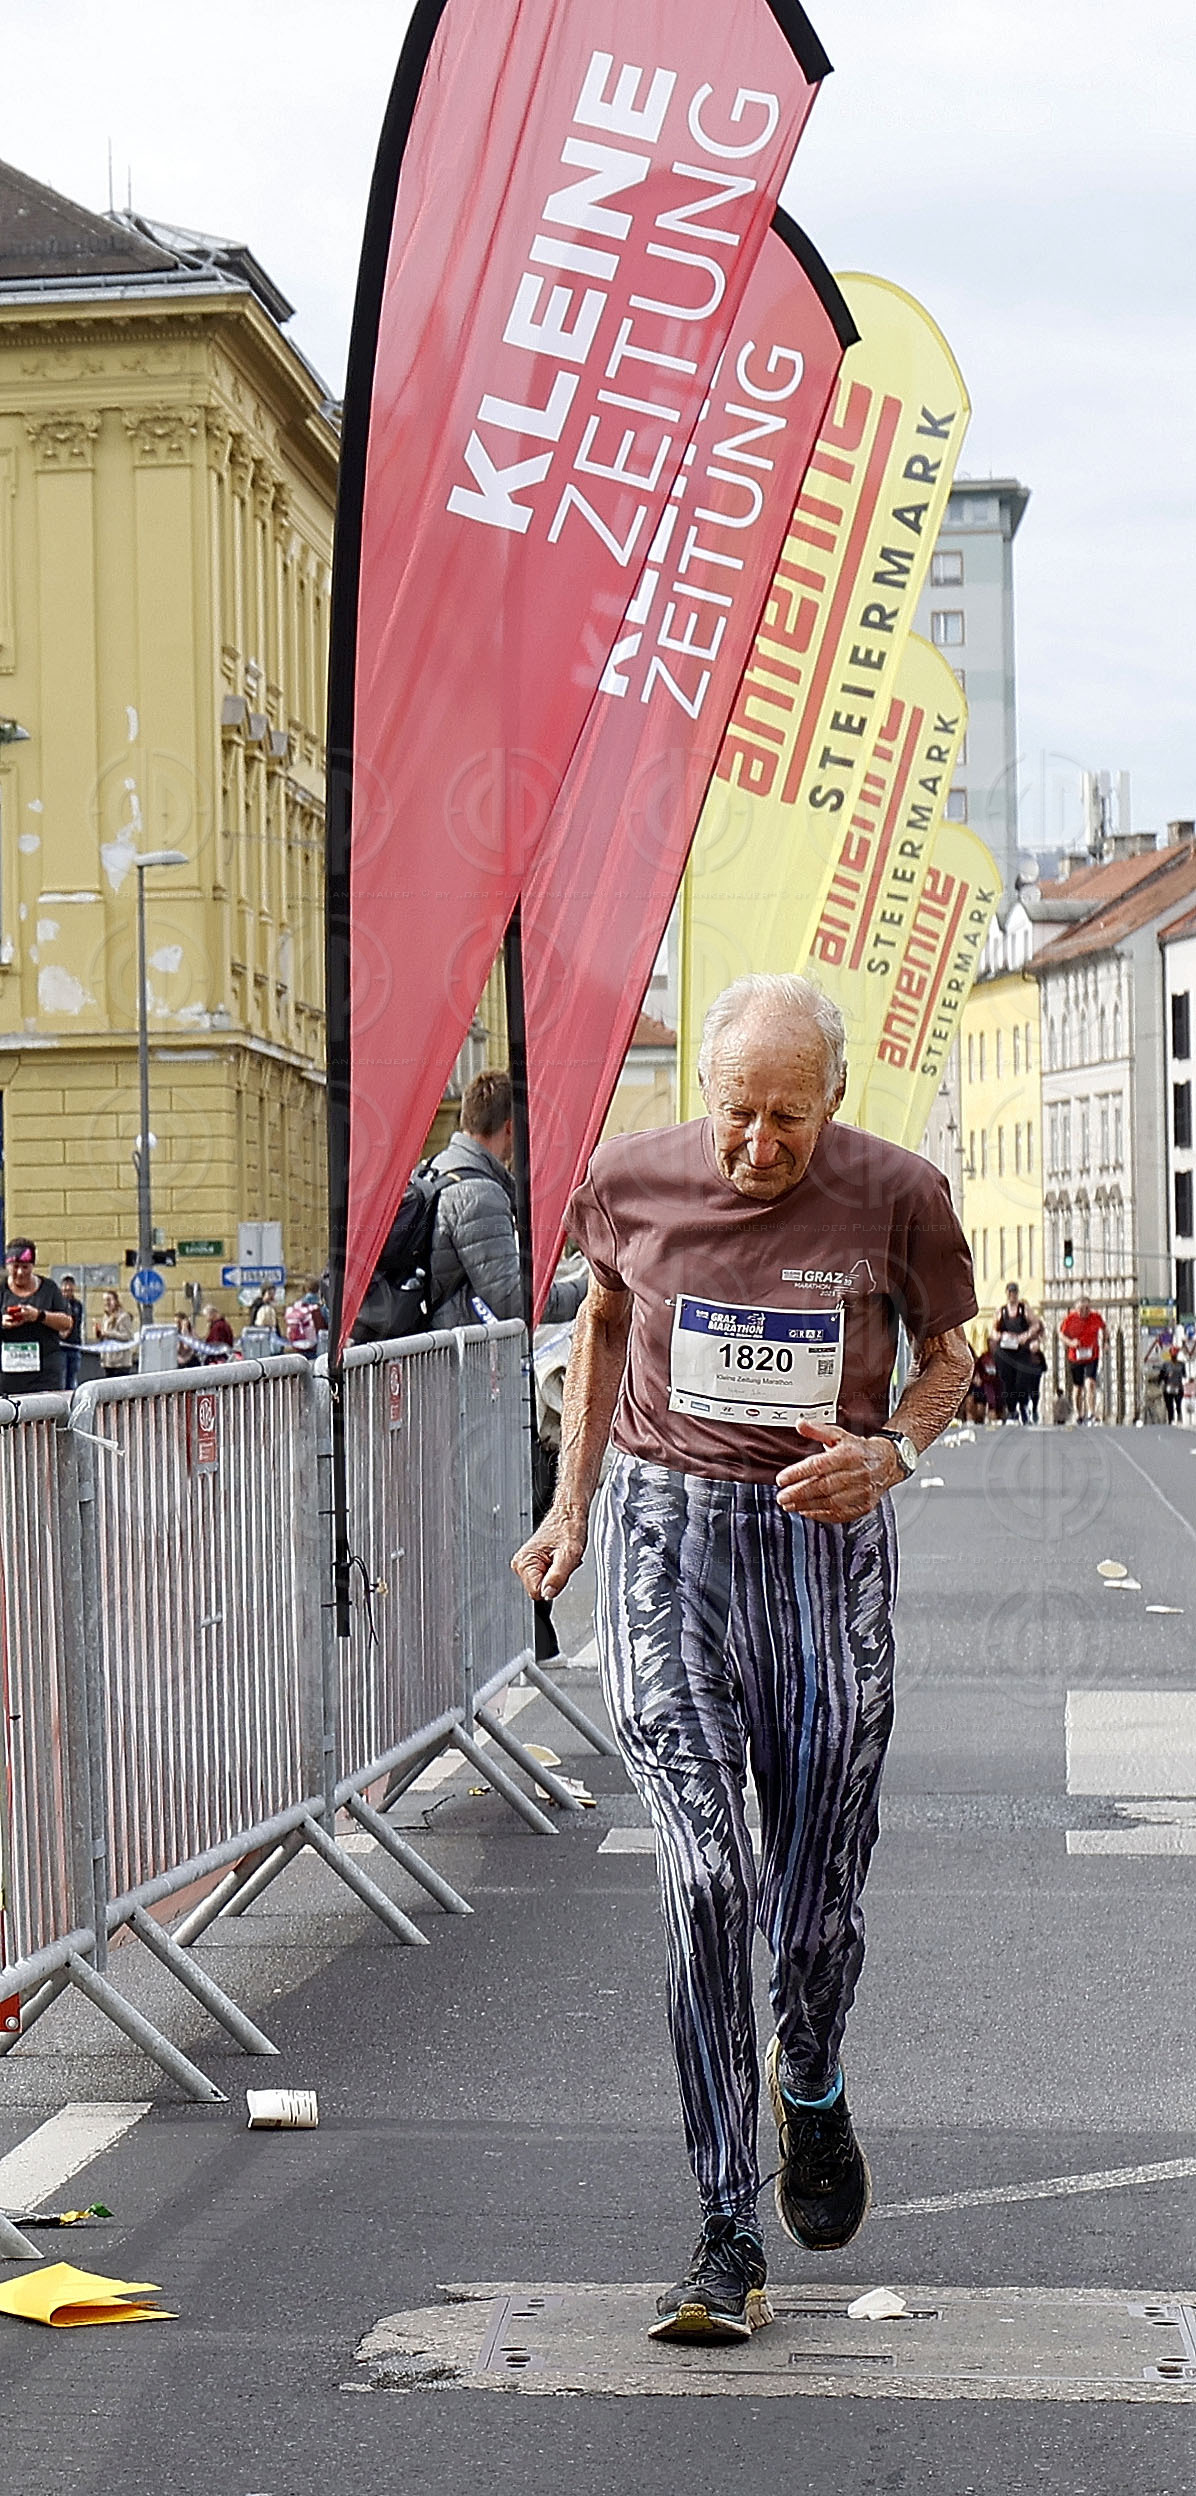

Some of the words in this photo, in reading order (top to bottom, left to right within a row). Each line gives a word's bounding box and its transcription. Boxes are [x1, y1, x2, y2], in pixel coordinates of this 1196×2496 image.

[447, 50, 678, 534] KLEINE
[547, 83, 779, 567] ZEITUNG
[640, 340, 804, 720] ZEITUNG
[716, 380, 873, 798] antenne
[809, 405, 956, 812] STEIERMARK
[867, 712, 959, 976] STEIERMARK
[877, 866, 956, 1069] antenne
[922, 887, 995, 1077] STEIERMARK
[708, 1320, 764, 1335] MARATHON
[710, 1312, 737, 1324] GRAZ
[719, 1343, 793, 1373] 1820
[804, 1270, 844, 1283] GRAZ
[737, 1375, 761, 1385] Zeitung
[762, 1377, 793, 1386] Marathon
